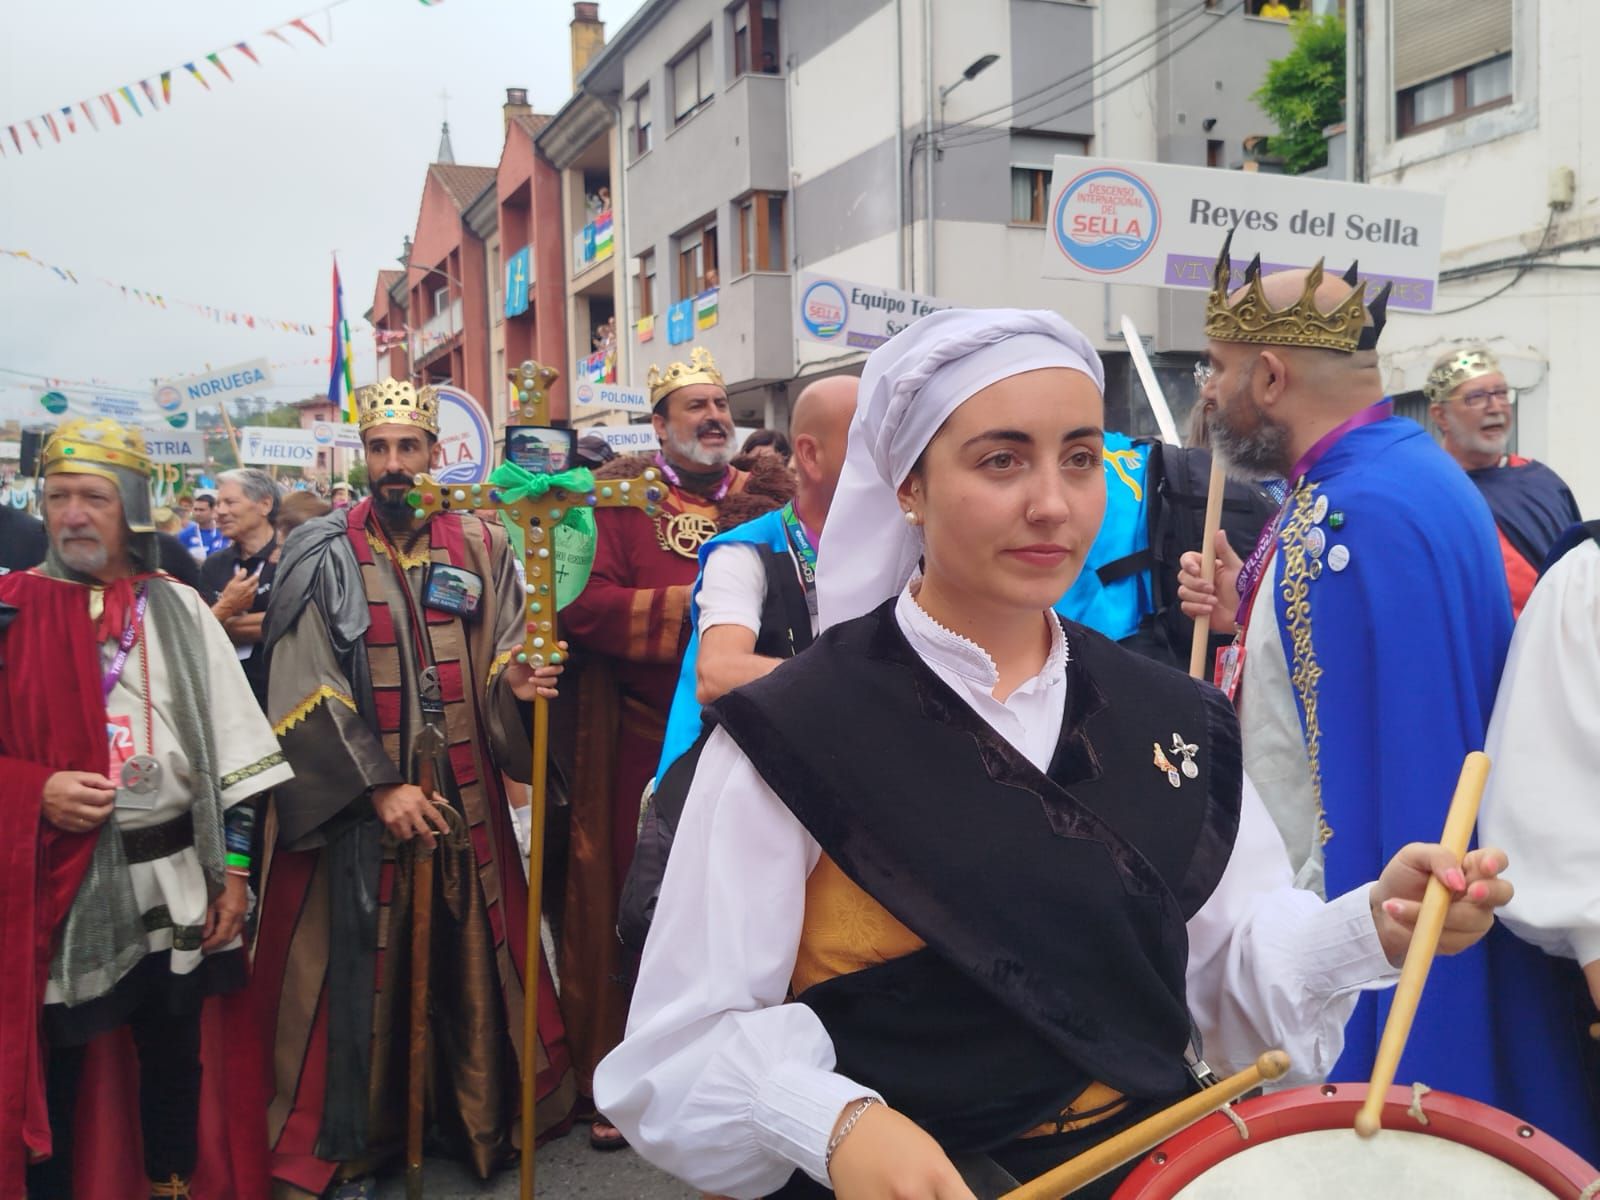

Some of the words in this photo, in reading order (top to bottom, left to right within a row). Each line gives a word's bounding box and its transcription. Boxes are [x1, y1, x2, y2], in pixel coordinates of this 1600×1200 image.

[1089, 183, 1135, 197] DESCENSO
[1077, 192, 1144, 208] INTERNACIONAL
[1101, 204, 1116, 215] DEL
[1072, 215, 1141, 238] SELLA
[1189, 198, 1279, 232] Reyes
[1289, 209, 1335, 238] del
[1345, 214, 1420, 247] Sella
[851, 287, 905, 314] Equipo
[809, 304, 841, 321] SELLA
[187, 368, 265, 400] NORUEGA
[600, 391, 645, 405] POLONIA
[607, 433, 638, 446] REINO
[146, 441, 192, 456] STRIA
[262, 445, 313, 460] HELIOS
